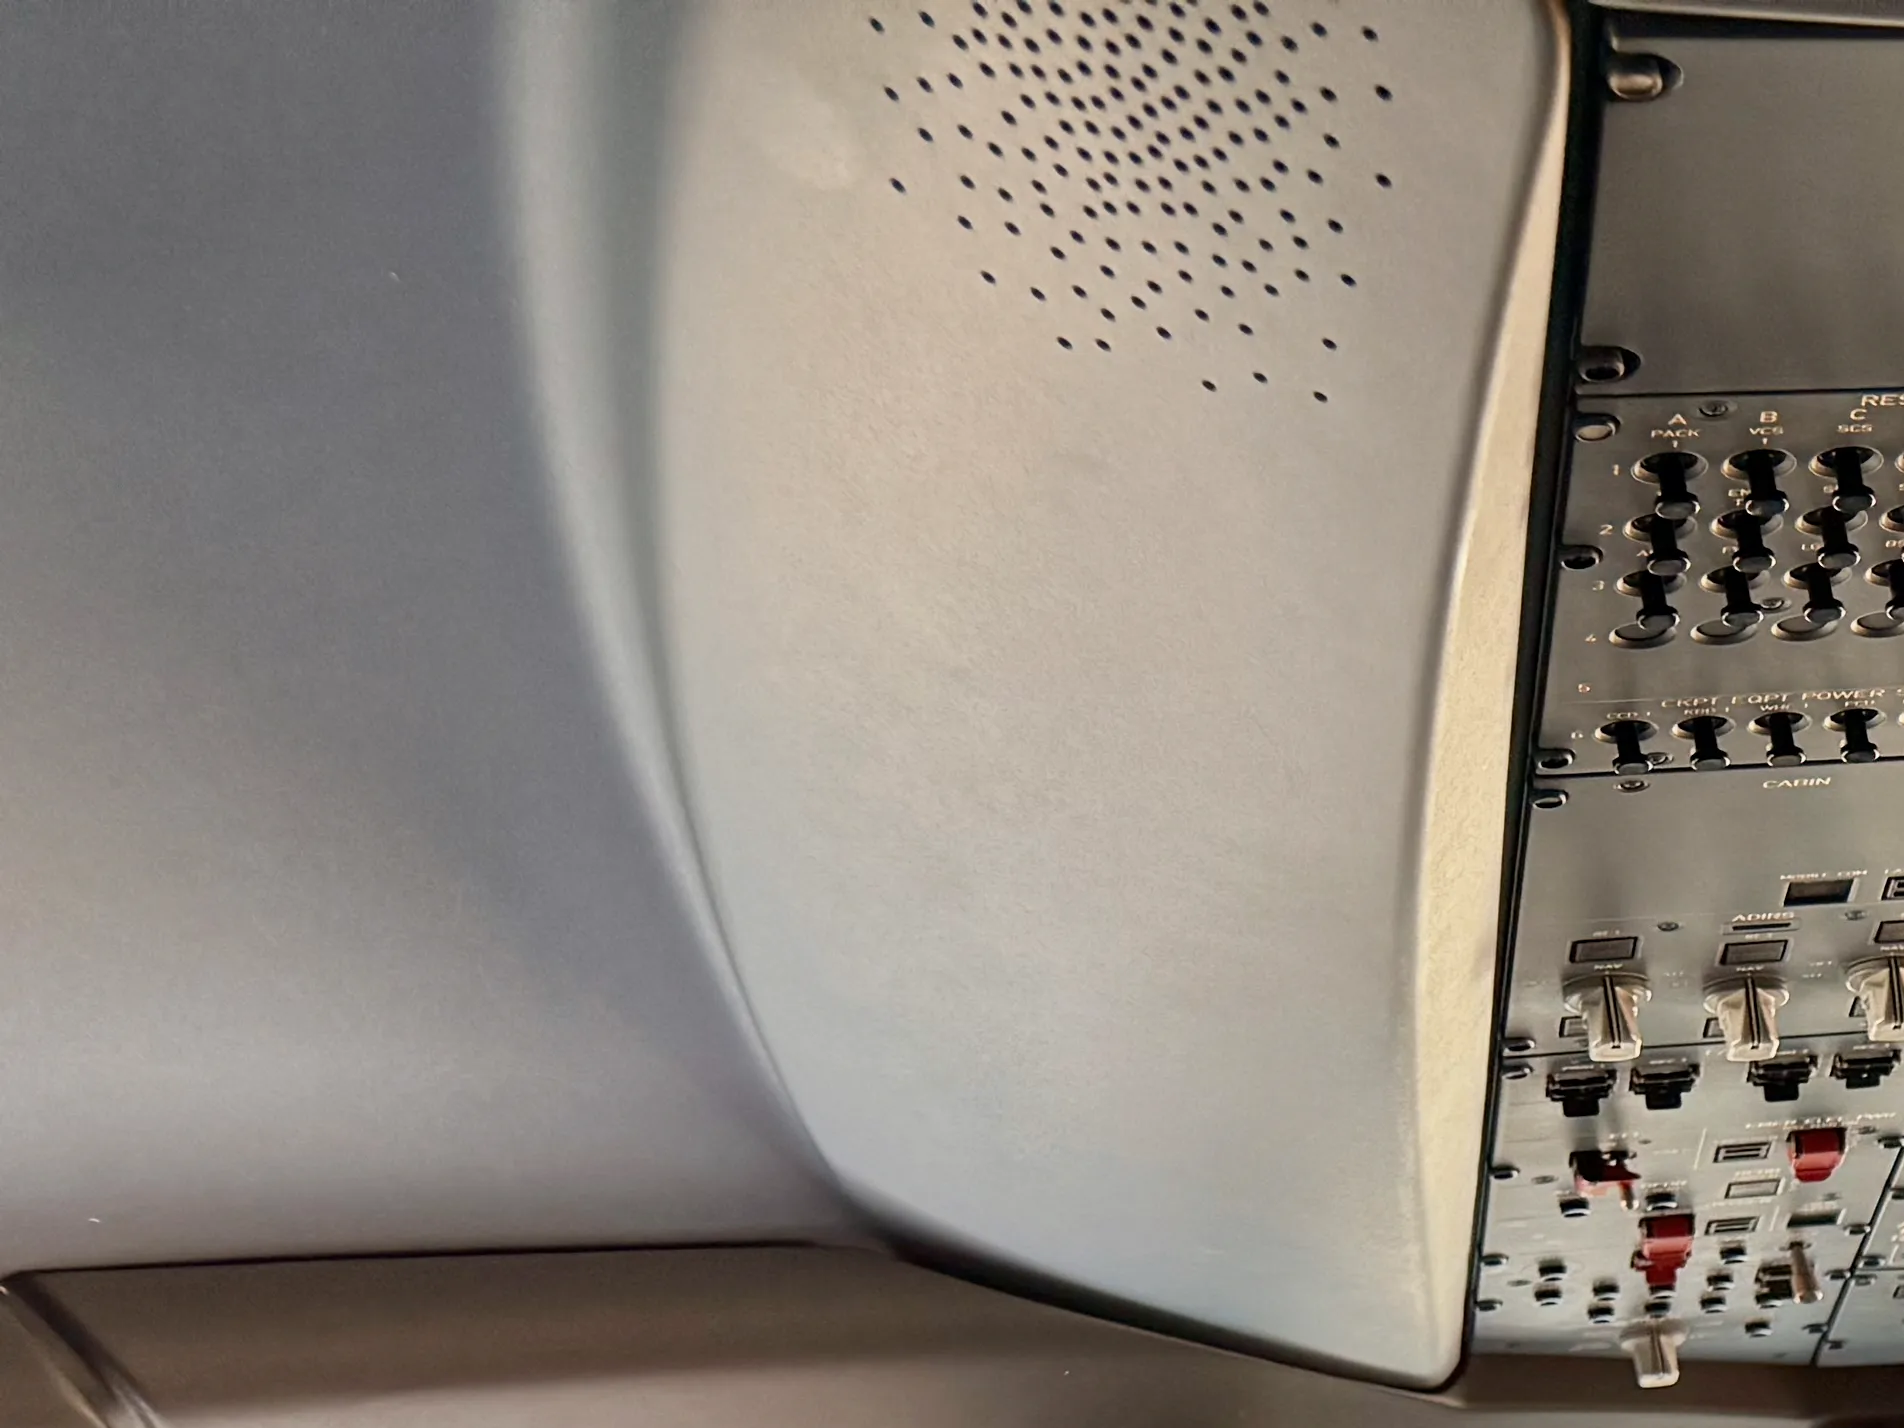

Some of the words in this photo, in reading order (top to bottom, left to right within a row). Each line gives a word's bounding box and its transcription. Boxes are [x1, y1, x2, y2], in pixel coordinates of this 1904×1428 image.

[1668, 413, 1688, 425] A
[1759, 411, 1778, 423] B
[1849, 408, 1868, 421] C
[1650, 428, 1701, 438] PACK
[1749, 426, 1785, 436] VCS
[1599, 524, 1614, 535] 2
[1592, 580, 1605, 591] 3
[1661, 696, 1720, 709] CKPT
[1802, 689, 1885, 701] POWER
[1761, 776, 1832, 789] CABIN
